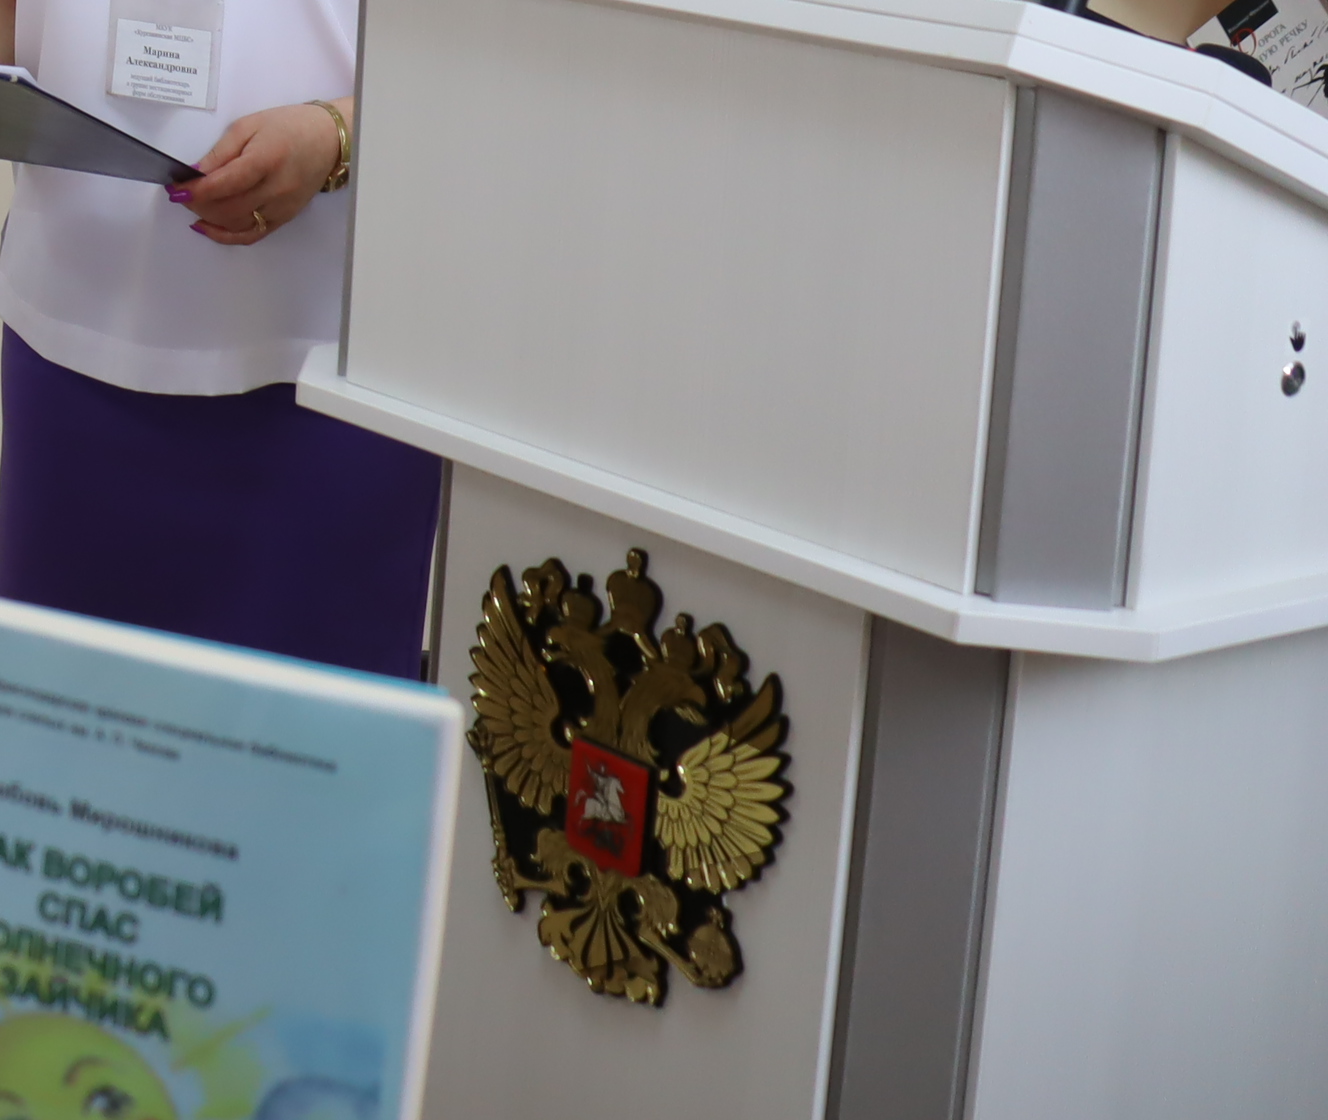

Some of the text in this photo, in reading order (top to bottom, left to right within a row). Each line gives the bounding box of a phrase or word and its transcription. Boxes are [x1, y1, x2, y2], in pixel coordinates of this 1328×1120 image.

[143, 46, 180, 59] Марина
[1279, 20, 1308, 46] РЕЧКУ
[126, 56, 197, 75] Александровна
[69, 799, 240, 861] Мирошникова
[42, 846, 225, 924] ВОРОБЕЙ
[37, 892, 140, 945] СПАС
